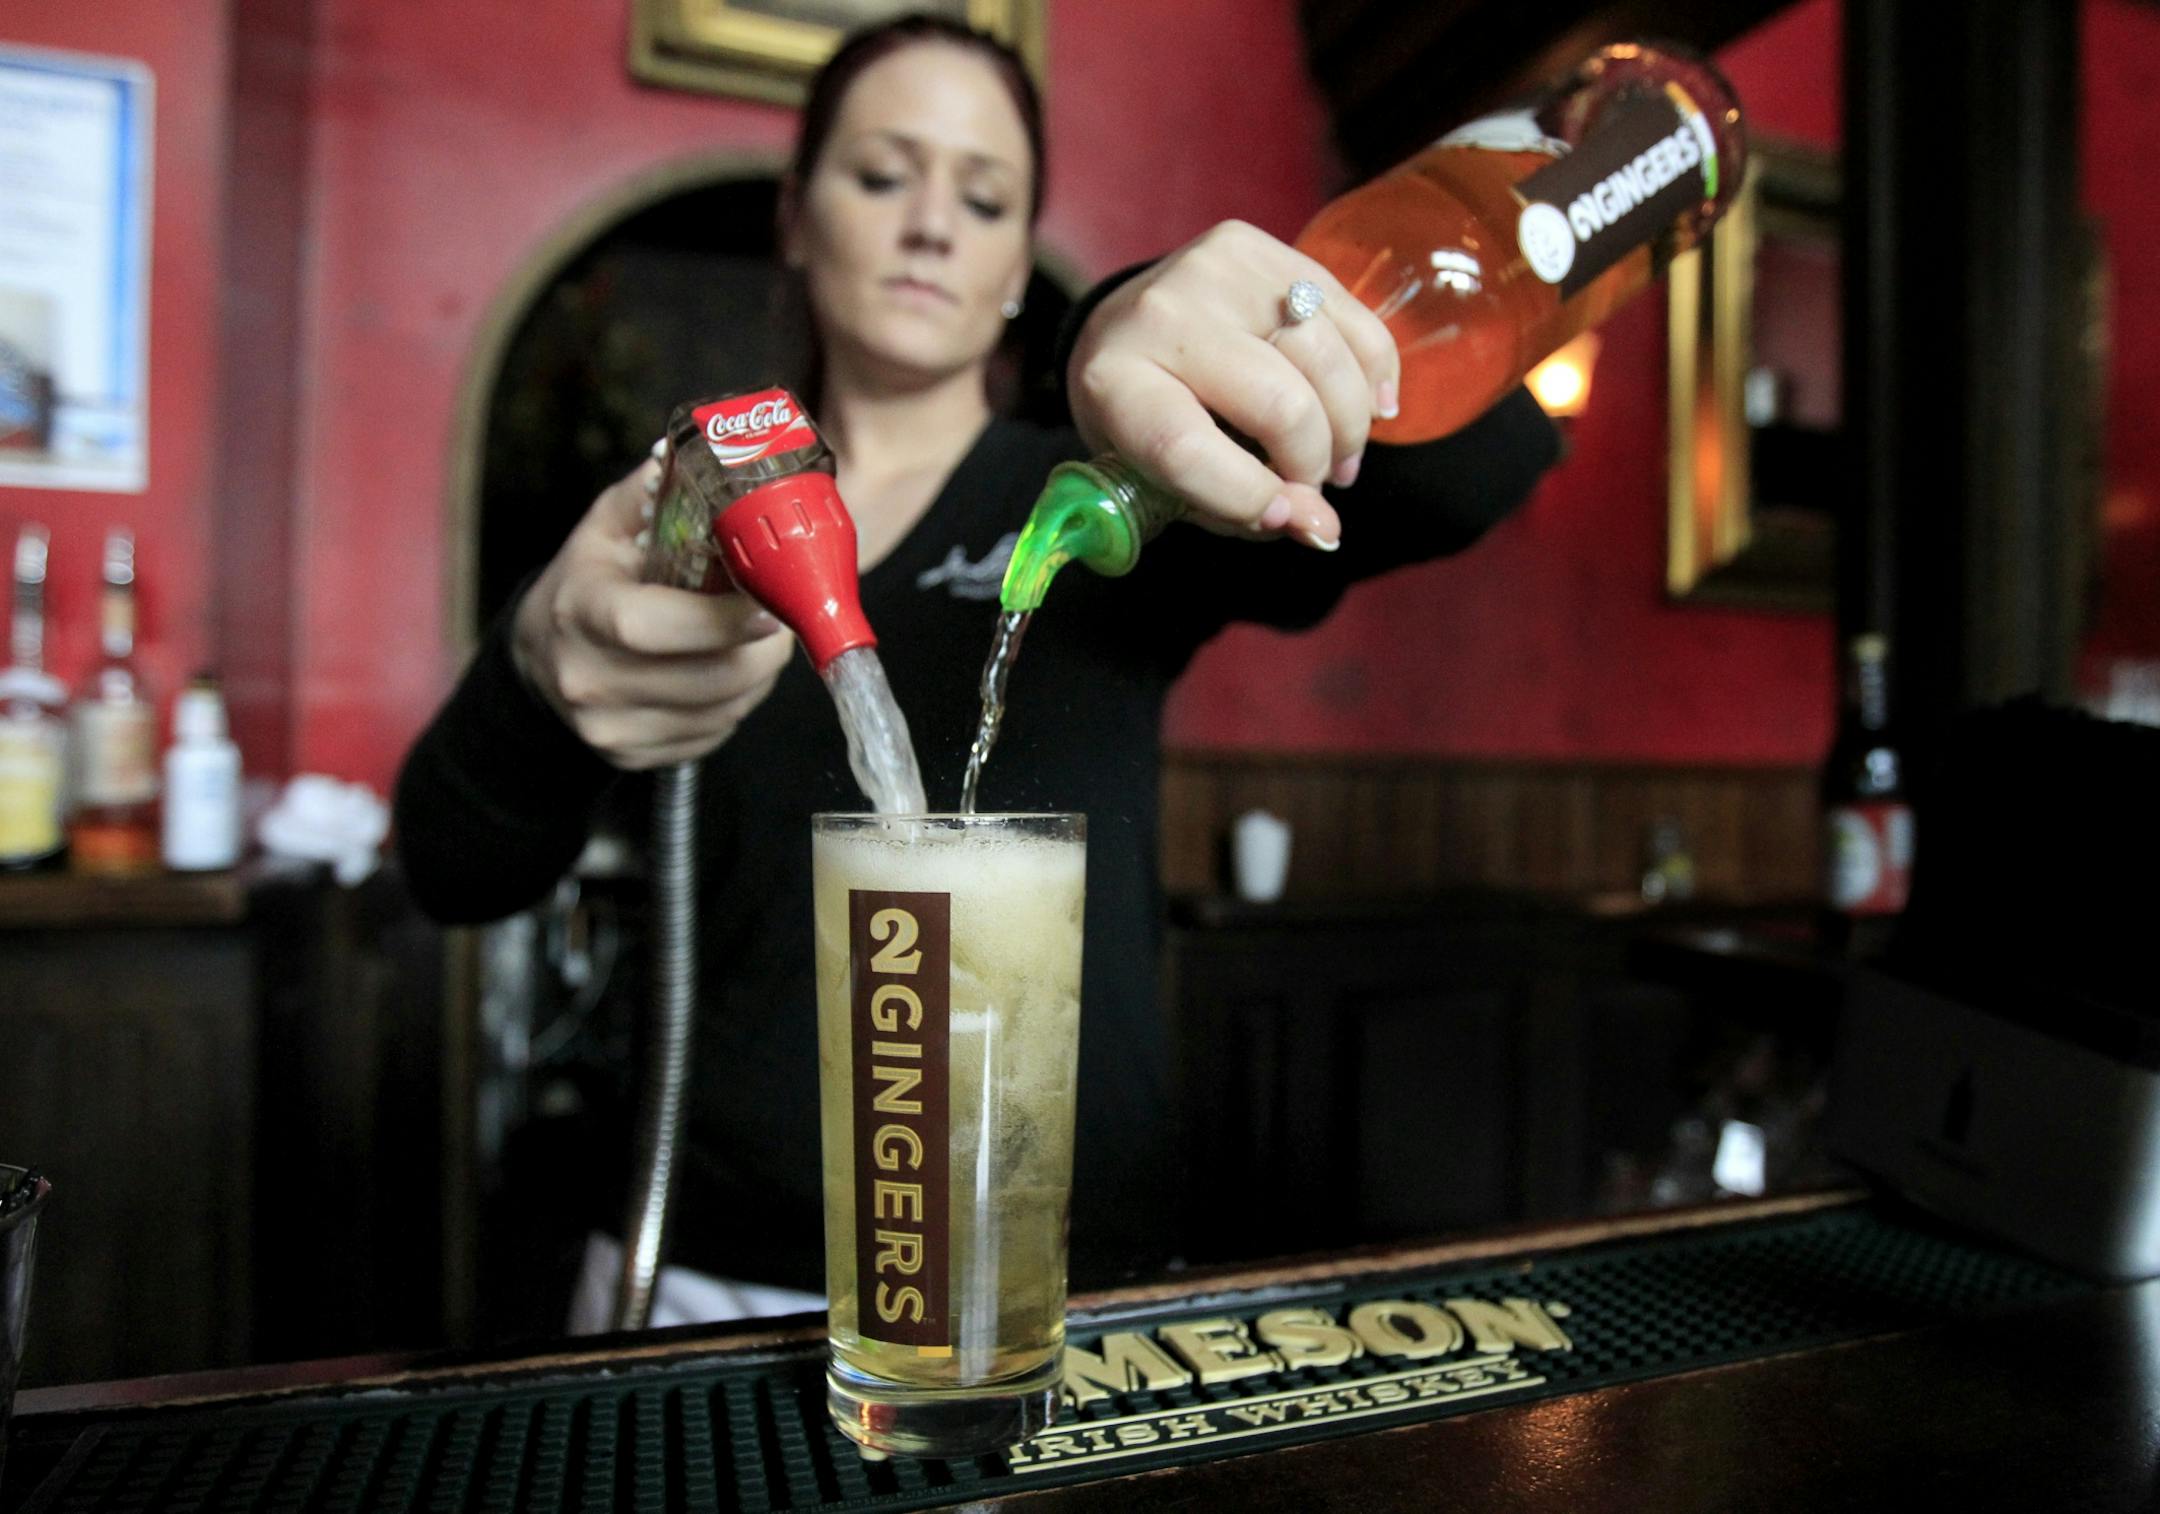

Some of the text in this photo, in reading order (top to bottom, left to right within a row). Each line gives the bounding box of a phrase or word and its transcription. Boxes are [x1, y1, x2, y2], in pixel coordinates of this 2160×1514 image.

[706, 398, 791, 441] Coca-Cola
[1008, 1359, 1528, 1464] IRISH WHISKEY
